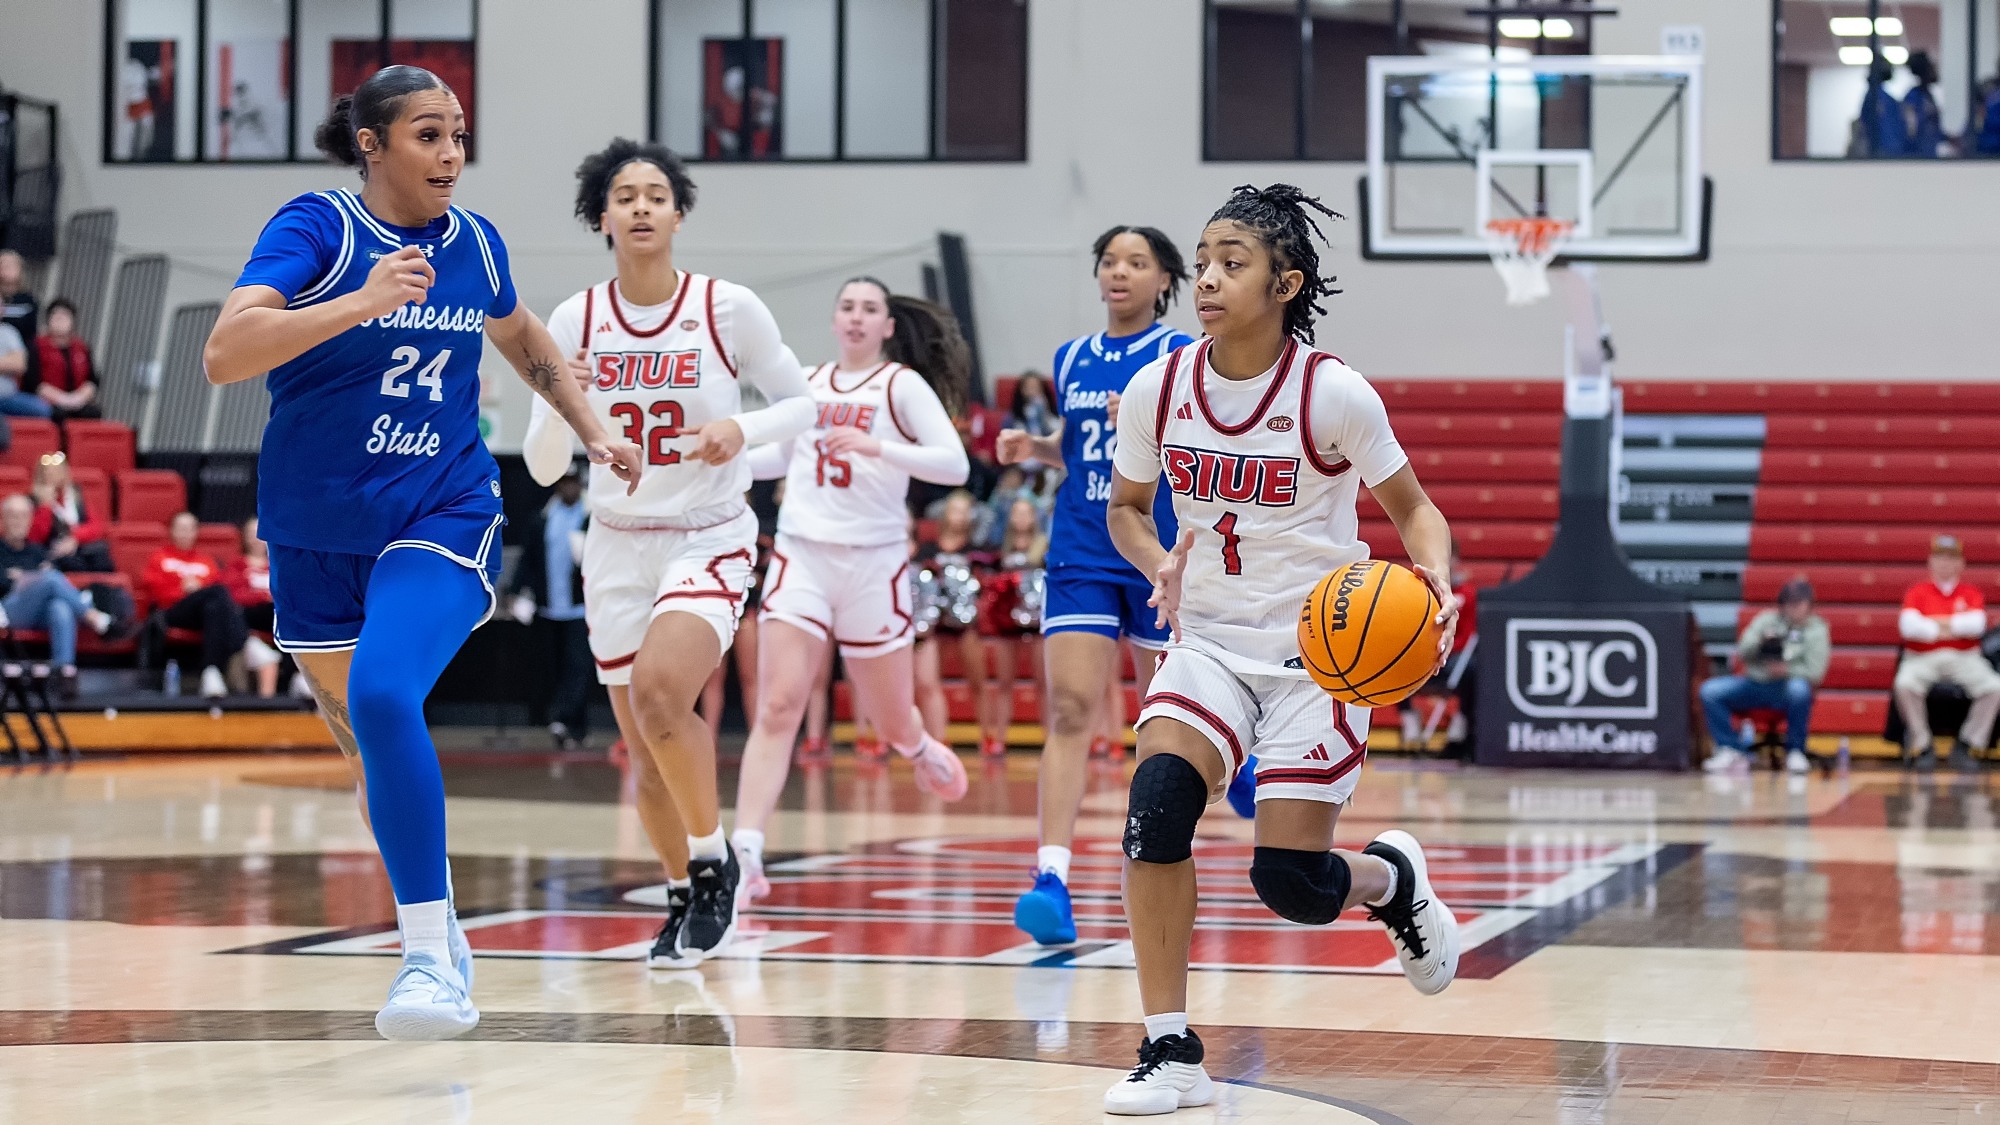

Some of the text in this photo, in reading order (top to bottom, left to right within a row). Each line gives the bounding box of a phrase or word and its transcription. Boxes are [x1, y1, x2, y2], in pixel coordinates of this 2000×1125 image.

[361, 304, 484, 333] ennessee
[380, 345, 452, 402] 24
[594, 349, 701, 391] SIUE
[366, 413, 441, 457] State
[610, 400, 684, 465] 32
[815, 402, 879, 435] IUE
[814, 440, 852, 488] 15
[1163, 444, 1301, 507] SIUE
[1212, 511, 1242, 575] 1
[1331, 561, 1379, 632] Wilson
[1526, 639, 1638, 707] BJC
[1508, 722, 1658, 754] HealthCare
